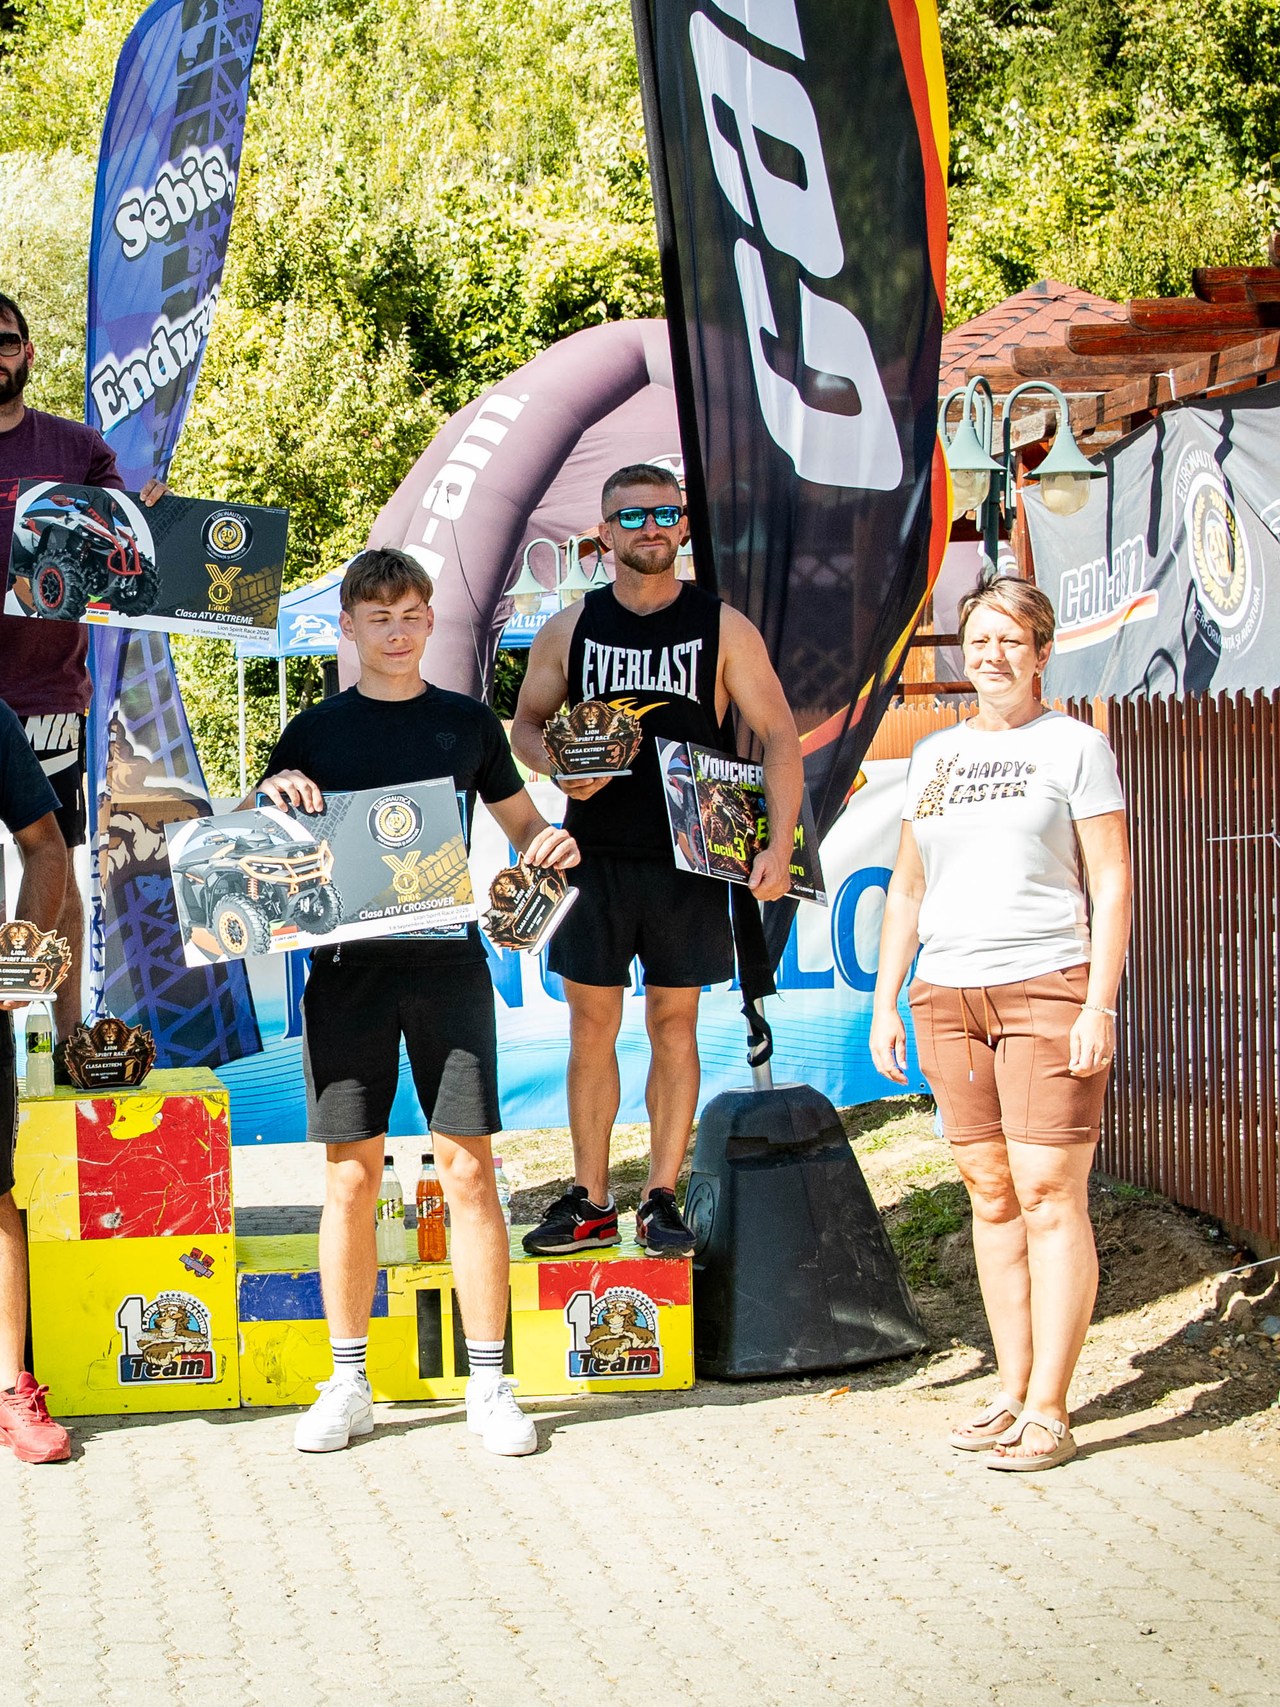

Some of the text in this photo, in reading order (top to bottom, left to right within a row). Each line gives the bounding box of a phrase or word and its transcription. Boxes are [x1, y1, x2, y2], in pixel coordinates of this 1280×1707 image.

[175, 608, 254, 625] Clasa ATV EXTREME
[582, 637, 702, 702] EVERLAST
[574, 735, 594, 743] SPIRIT
[564, 747, 583, 755] CLASA
[605, 744, 621, 764] 3
[697, 754, 764, 786] VOUCHER
[967, 761, 1026, 779] HAPPY
[949, 780, 1027, 804] EASTER
[708, 836, 747, 861] Locul 3
[788, 863, 805, 877] uro
[359, 896, 455, 920] Clasa ATV CROSSOVER
[29, 967, 47, 987] 3
[142, 1302, 208, 1335] LION RACING
[590, 1299, 655, 1331] LION RACING
[130, 1356, 204, 1379] Team
[579, 1353, 652, 1375] Team
